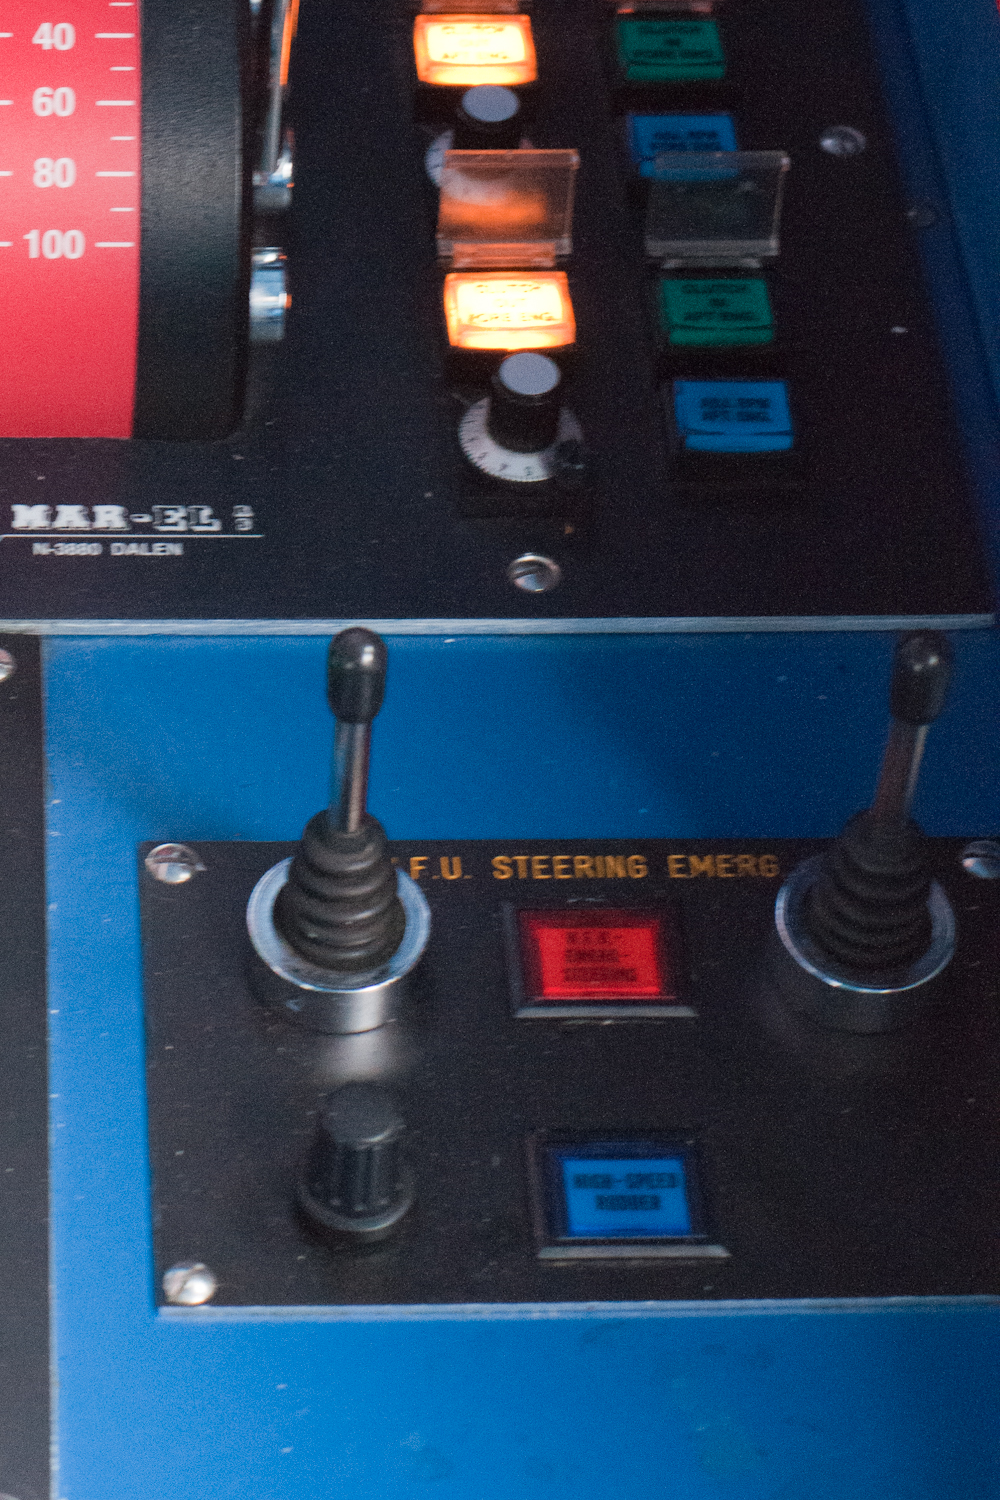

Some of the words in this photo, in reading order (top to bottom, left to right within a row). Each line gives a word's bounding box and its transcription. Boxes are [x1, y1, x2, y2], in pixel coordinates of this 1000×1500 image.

[31, 22, 76, 51] 40
[32, 86, 76, 117] 60
[32, 157, 76, 188] 80
[23, 229, 85, 259] 100
[11, 504, 222, 531] MAR-EL
[111, 543, 183, 556] DALEN
[491, 854, 649, 880] STEERING
[667, 854, 781, 879] EMERG
